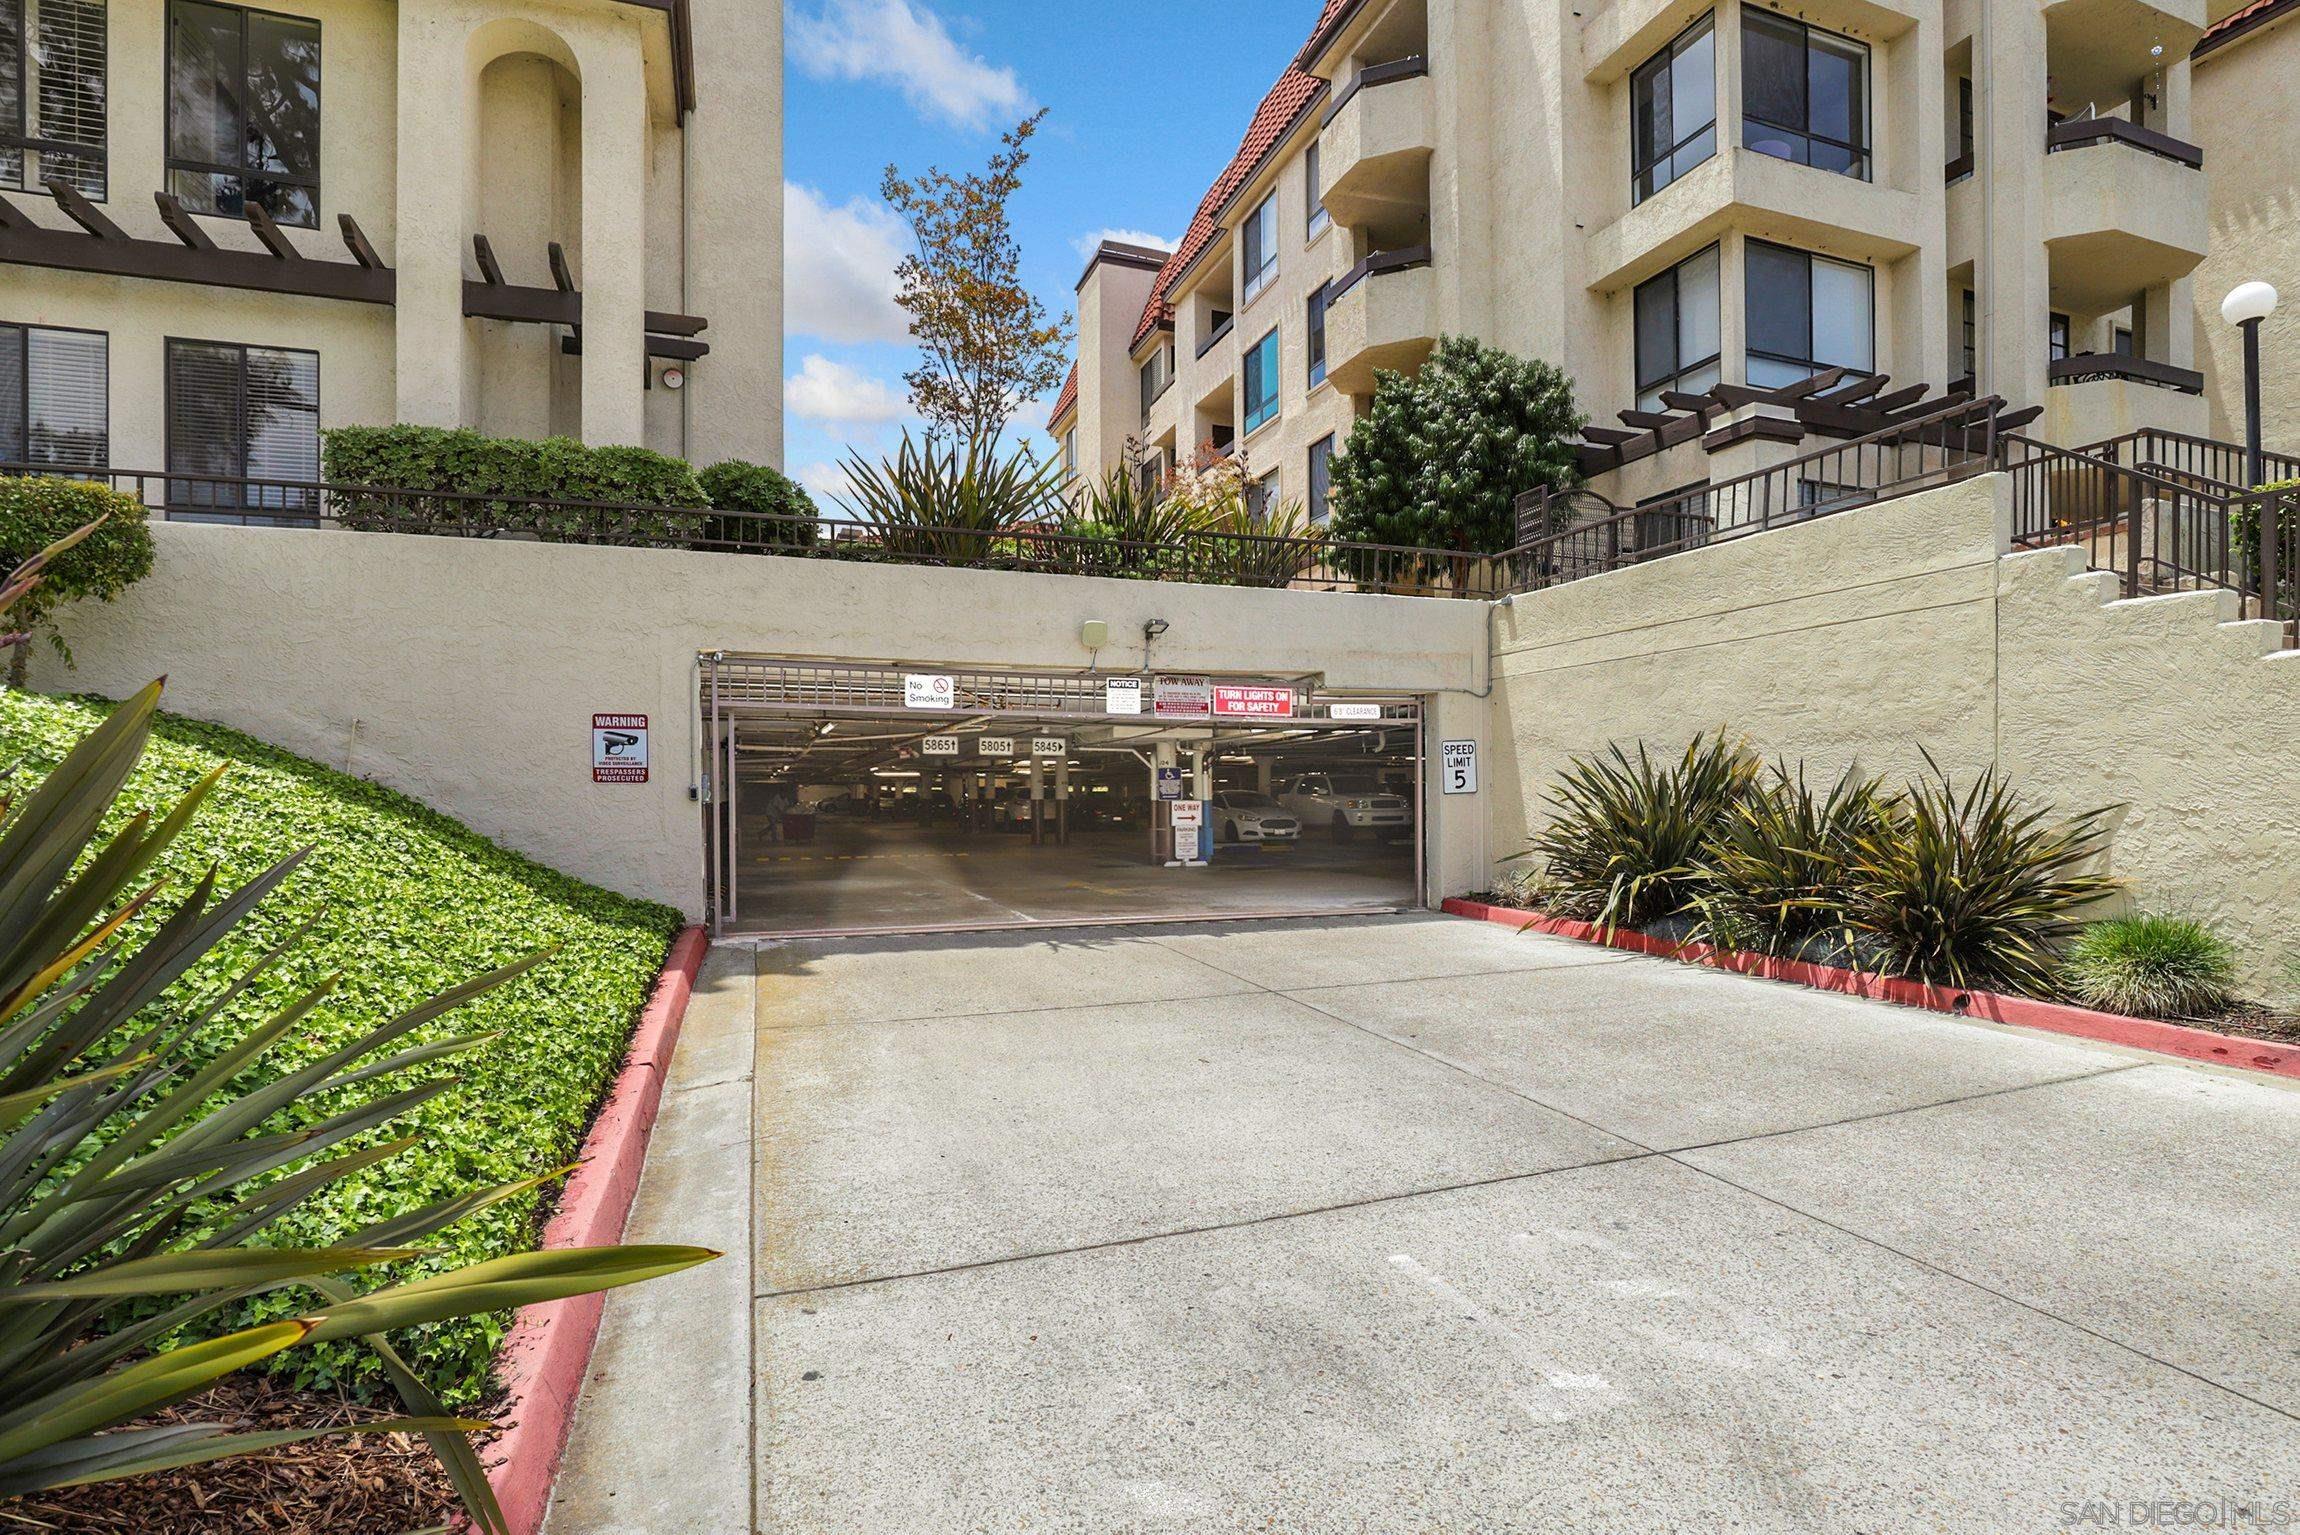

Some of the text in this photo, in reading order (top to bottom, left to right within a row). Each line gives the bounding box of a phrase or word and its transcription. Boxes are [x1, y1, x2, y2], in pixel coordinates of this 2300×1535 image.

[909, 681, 923, 690] No
[1109, 680, 1138, 689] NOTICE
[1159, 677, 1205, 687] TOW AWAY
[909, 693, 950, 706] Smoking
[1218, 689, 1242, 700] TURN
[1243, 690, 1275, 701] LIGHTS
[1275, 691, 1289, 702] ON
[1227, 700, 1280, 713] FOR SAFETY
[1345, 707, 1378, 716] CLEARANCE
[595, 716, 646, 728] WARNING
[924, 739, 951, 751] 5865
[980, 740, 1006, 752] 5805
[1034, 741, 1058, 753] 5845
[1444, 744, 1475, 755] SPEED
[1447, 756, 1471, 768] LIMIT
[1454, 769, 1467, 790] 5
[1187, 803, 1200, 811] WAY
